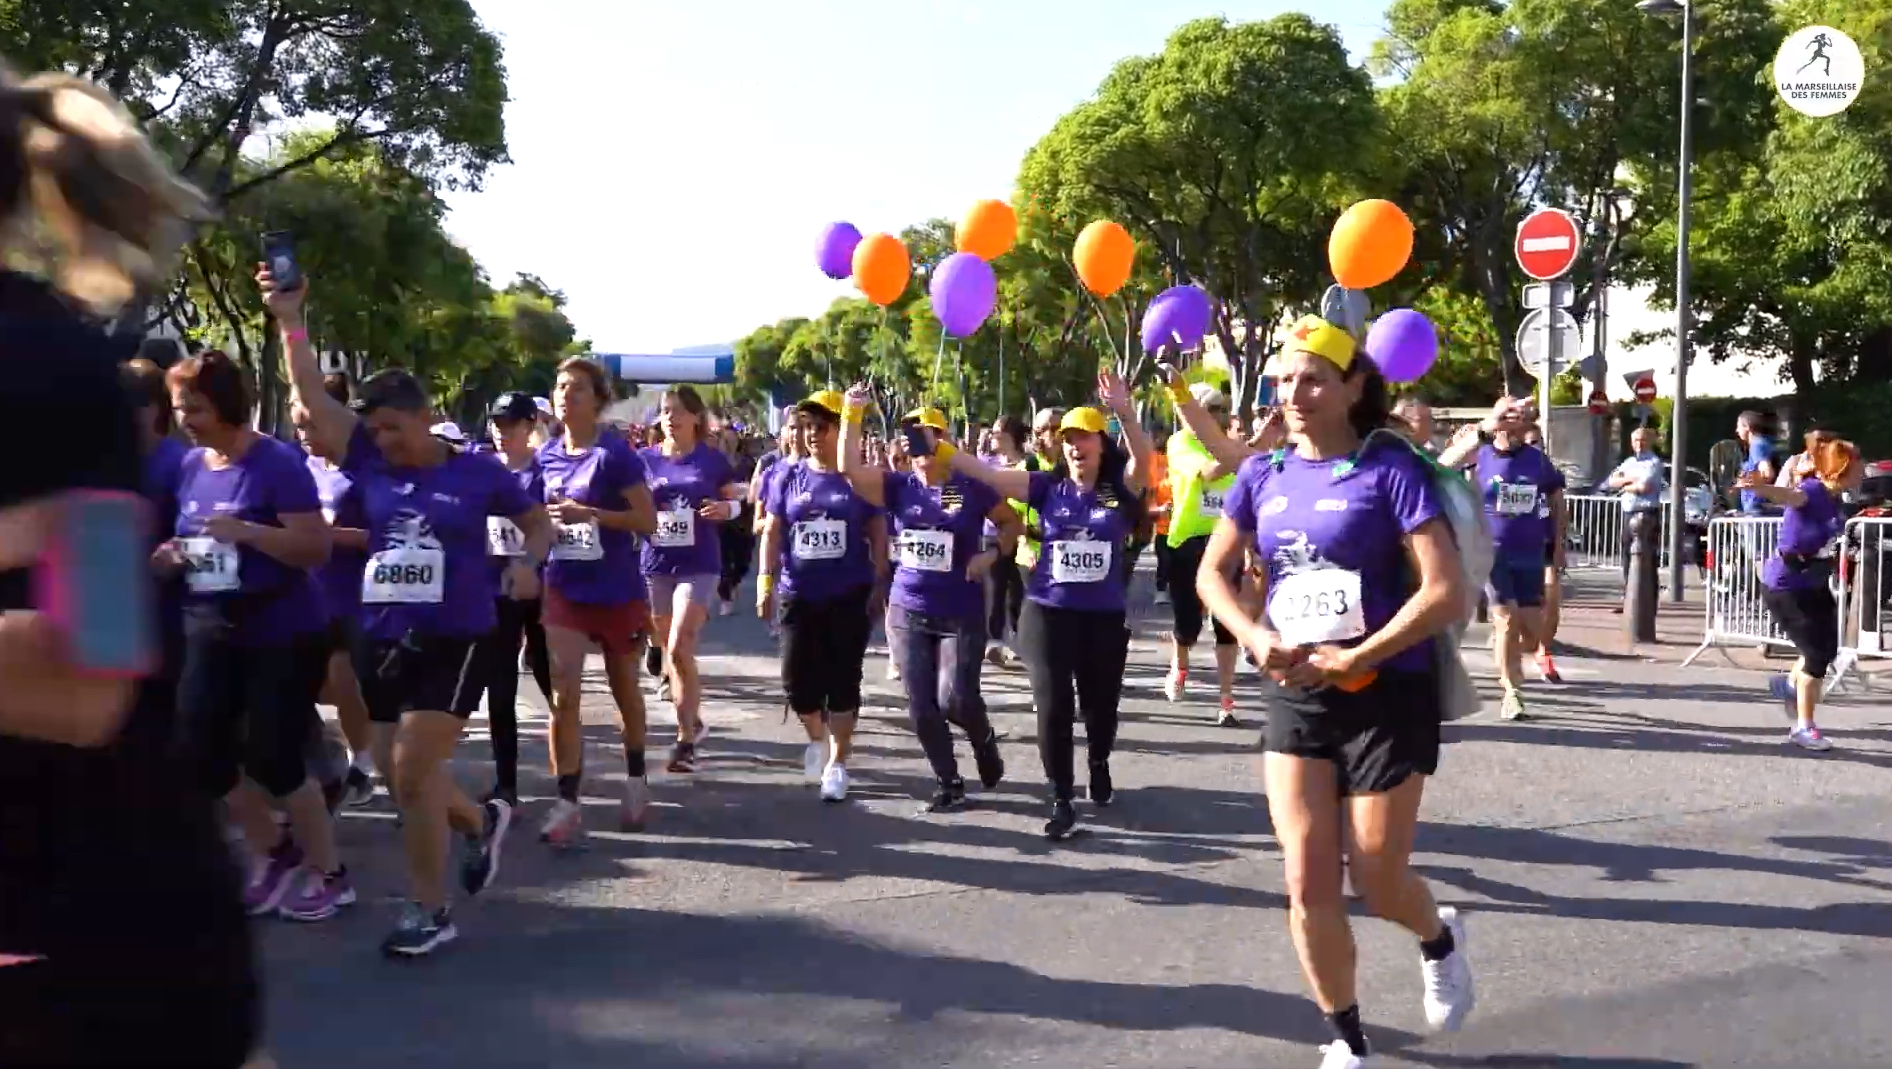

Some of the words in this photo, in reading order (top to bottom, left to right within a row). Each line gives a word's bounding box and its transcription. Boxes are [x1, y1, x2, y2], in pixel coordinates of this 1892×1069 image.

[802, 530, 841, 547] 4313
[907, 542, 946, 558] 4264
[1060, 552, 1104, 569] 4305
[373, 563, 434, 585] 6860
